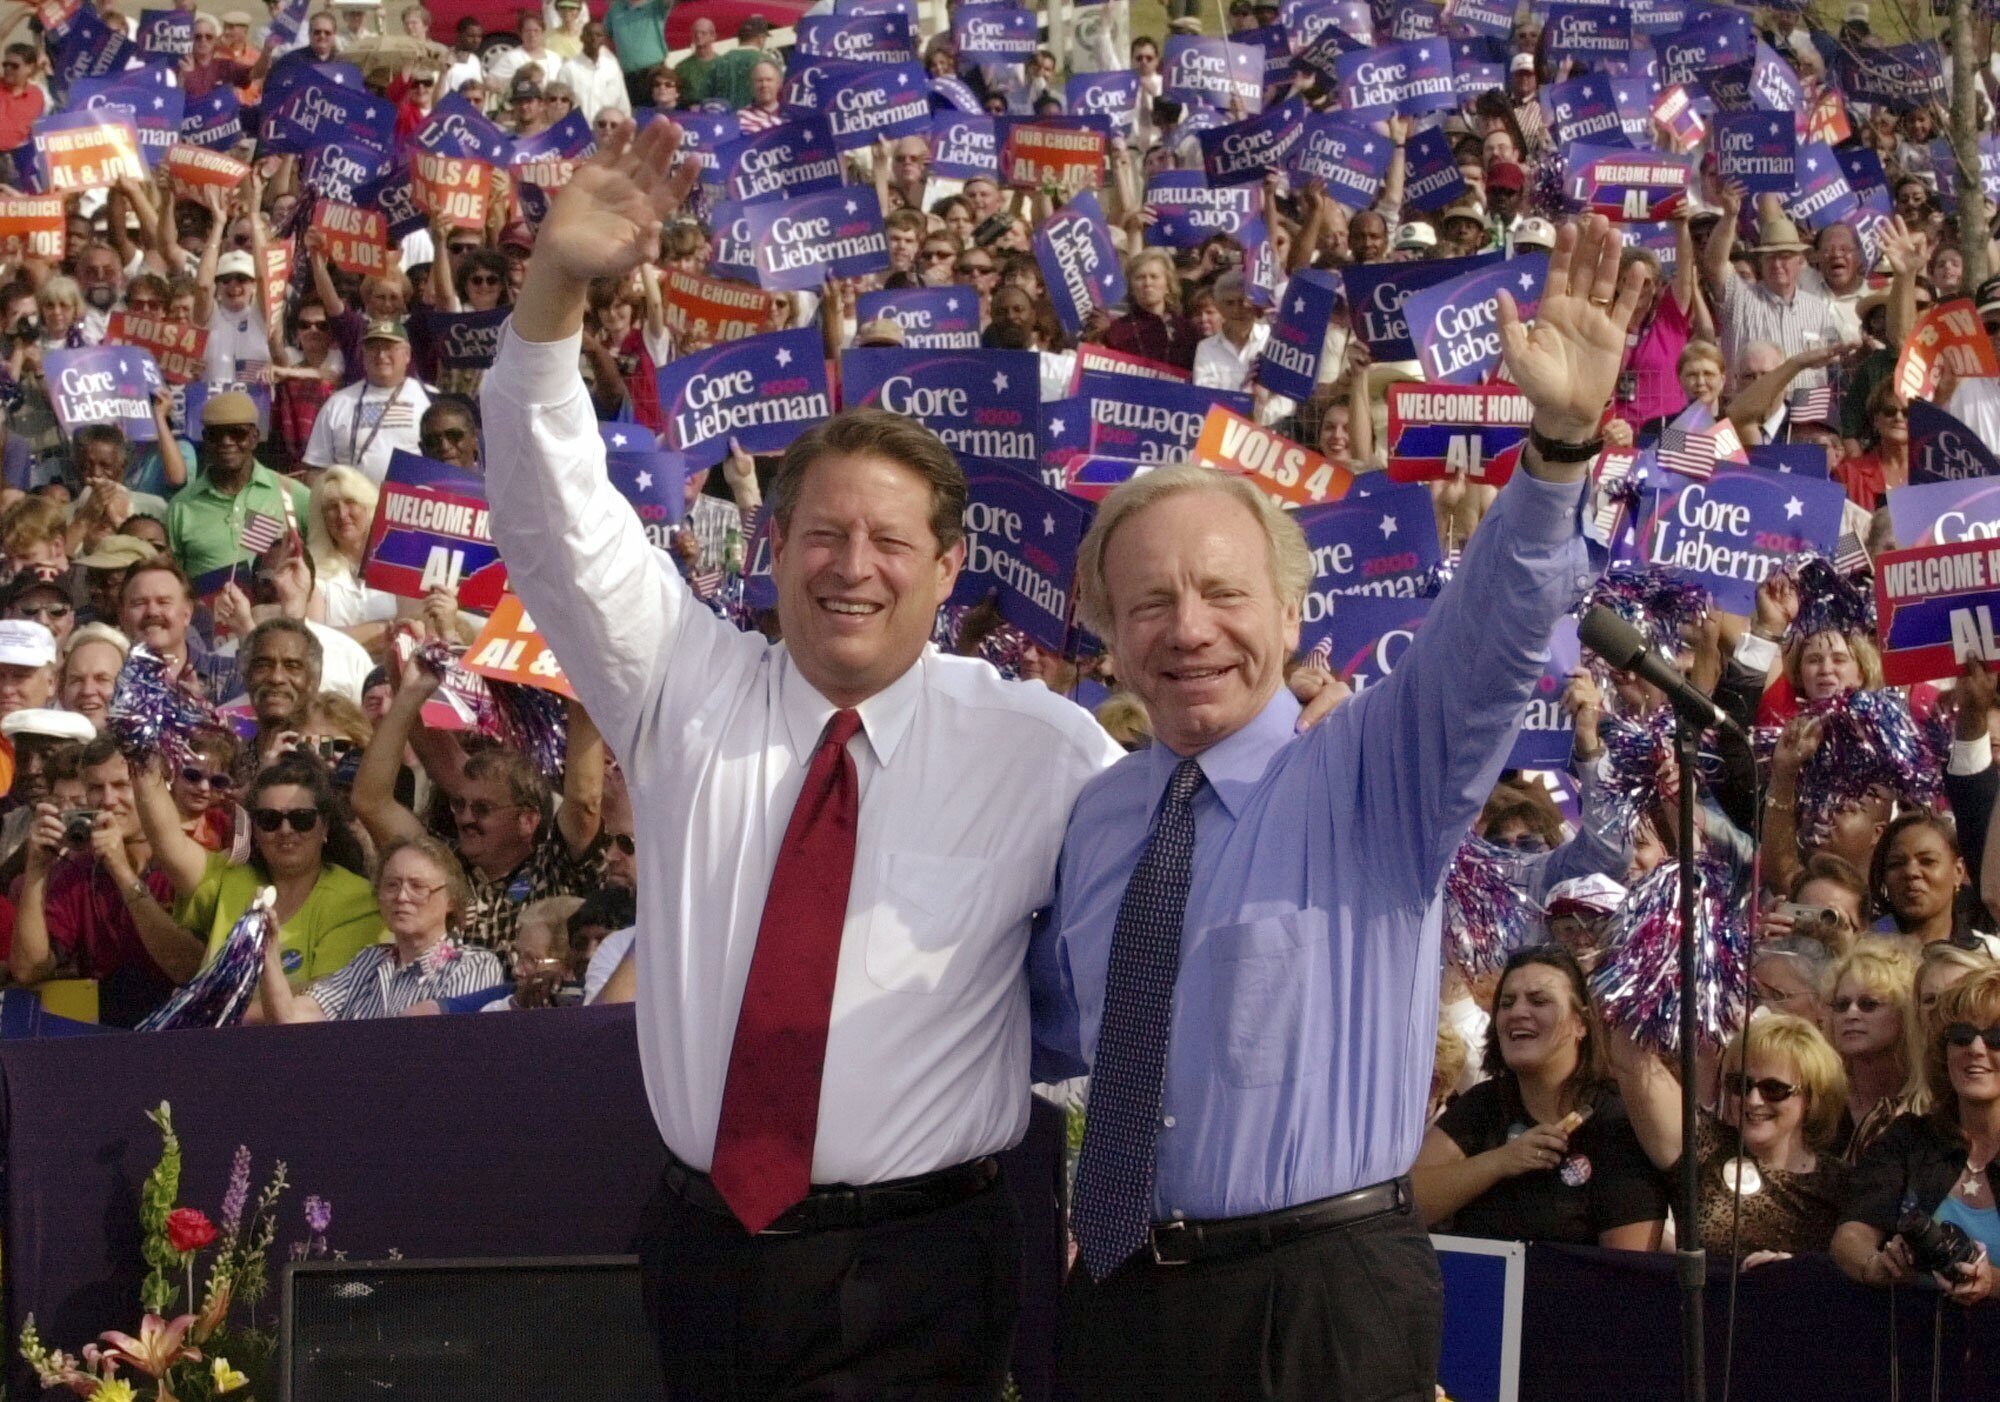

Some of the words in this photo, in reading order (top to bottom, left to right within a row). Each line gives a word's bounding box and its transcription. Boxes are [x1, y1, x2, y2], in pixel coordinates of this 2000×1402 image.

[154, 20, 192, 40] Gore
[967, 17, 1004, 37] Gore
[1400, 7, 1434, 30] Gore
[1453, 2, 1513, 29] Lieberman
[1560, 15, 1598, 34] Gore
[833, 30, 874, 51] Gore
[960, 33, 1037, 52] Lieberman
[1552, 31, 1629, 51] Lieberman
[1666, 44, 1706, 66] Gore
[1181, 48, 1226, 74] Gore
[1356, 62, 1407, 87] Gore
[305, 85, 347, 125] Gore
[836, 87, 887, 113] Gore
[1085, 86, 1127, 109] Gore
[1350, 75, 1453, 110] Lieberman
[829, 98, 930, 137] Lieberman
[48, 135, 74, 152] OUR
[949, 123, 996, 149] Gore
[1015, 129, 1042, 148] OUR
[1044, 130, 1101, 151] CHOICE!
[1214, 121, 1304, 177] Lieberman
[1222, 127, 1274, 156] Gore
[1309, 129, 1347, 160] Gore
[1719, 127, 1754, 151] Gore
[194, 153, 247, 176] CHOICE!
[322, 143, 367, 184] Gore
[740, 144, 794, 175] Gore
[1013, 158, 1038, 183] AL
[1300, 149, 1378, 195] Lieberman
[53, 165, 77, 188] AL
[81, 164, 98, 184] &
[465, 162, 481, 188] 4
[521, 163, 573, 188] VOLS
[735, 157, 840, 201] Lieberman
[1595, 165, 1650, 184] WELCOME
[1652, 165, 1685, 185] HOME
[9, 202, 61, 218] CHOICE!
[443, 191, 483, 220] JOE
[1148, 187, 1251, 213] Lieberman
[1622, 189, 1650, 219] AL
[322, 207, 361, 235] VOLS
[366, 213, 379, 239] 4
[771, 216, 832, 246] Gore
[1189, 207, 1241, 232] Gore
[28, 231, 63, 256] JOE
[333, 241, 346, 261] &
[350, 240, 383, 269] JOE
[765, 231, 888, 274] Lieberman
[1071, 217, 1100, 272] Gore
[266, 248, 288, 275] AL
[268, 279, 284, 297] &
[670, 271, 702, 296] OUR
[702, 281, 765, 311] CHOICE!
[123, 314, 179, 348] VOLS
[180, 331, 197, 349] 4
[1434, 297, 1499, 340] Gore
[61, 368, 116, 398] Gore
[685, 369, 754, 410] Gore
[880, 375, 968, 418] Gore
[57, 395, 152, 423] Lieberman
[1397, 392, 1484, 421] WELCOME
[675, 392, 832, 451] Lieberman
[1219, 418, 1308, 490] VOLS
[1304, 464, 1335, 501] 4
[1445, 434, 1486, 478] AL
[384, 491, 473, 534] WELCOME
[1678, 483, 1751, 536] Gore
[1650, 520, 1784, 584] Lieberm
[1884, 551, 1985, 599] WELCOME
[1949, 605, 2000, 667] AL
[471, 637, 528, 672] AL
[528, 649, 561, 679] &
